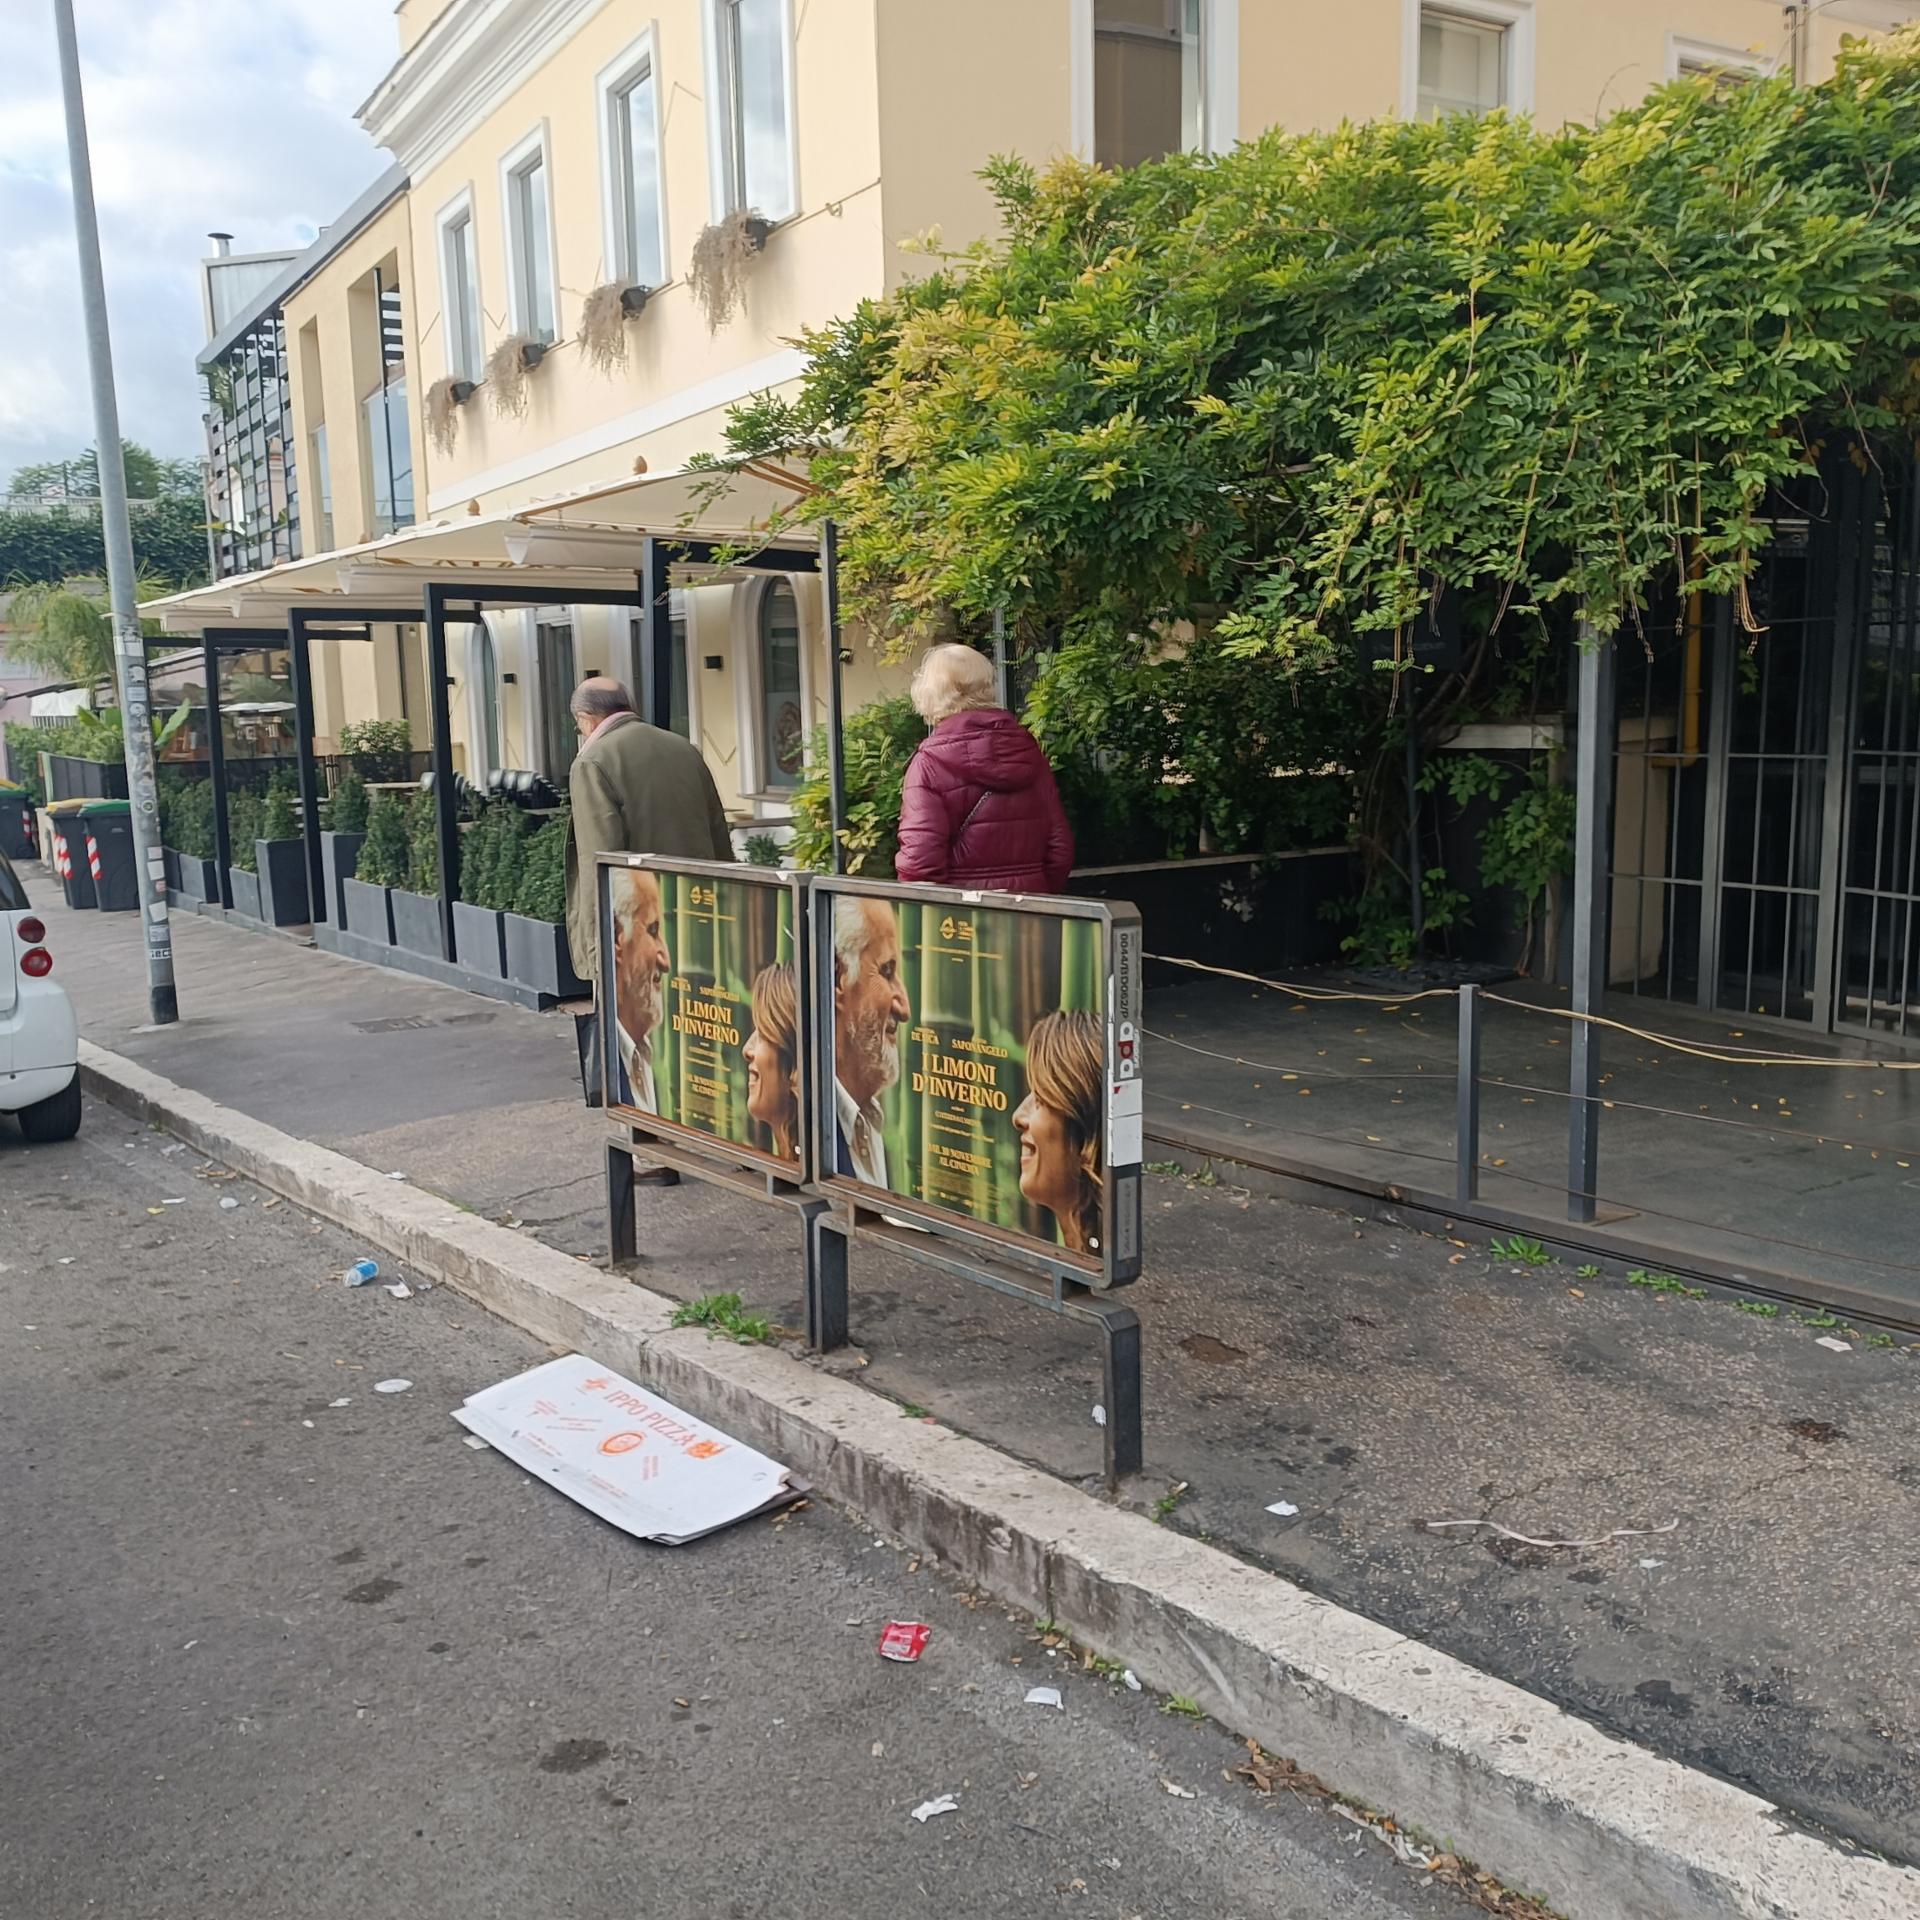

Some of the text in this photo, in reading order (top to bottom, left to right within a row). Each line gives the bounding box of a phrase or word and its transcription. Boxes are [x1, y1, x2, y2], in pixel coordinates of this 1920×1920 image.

[678, 998, 732, 1025] I LIMONI
[672, 1014, 740, 1046] D'INVERNO
[922, 1051, 997, 1086] I LIMONI
[912, 1071, 1008, 1112] D'INVERNO
[603, 1390, 648, 1415] IPPO
[640, 1411, 697, 1447] PIZZA
